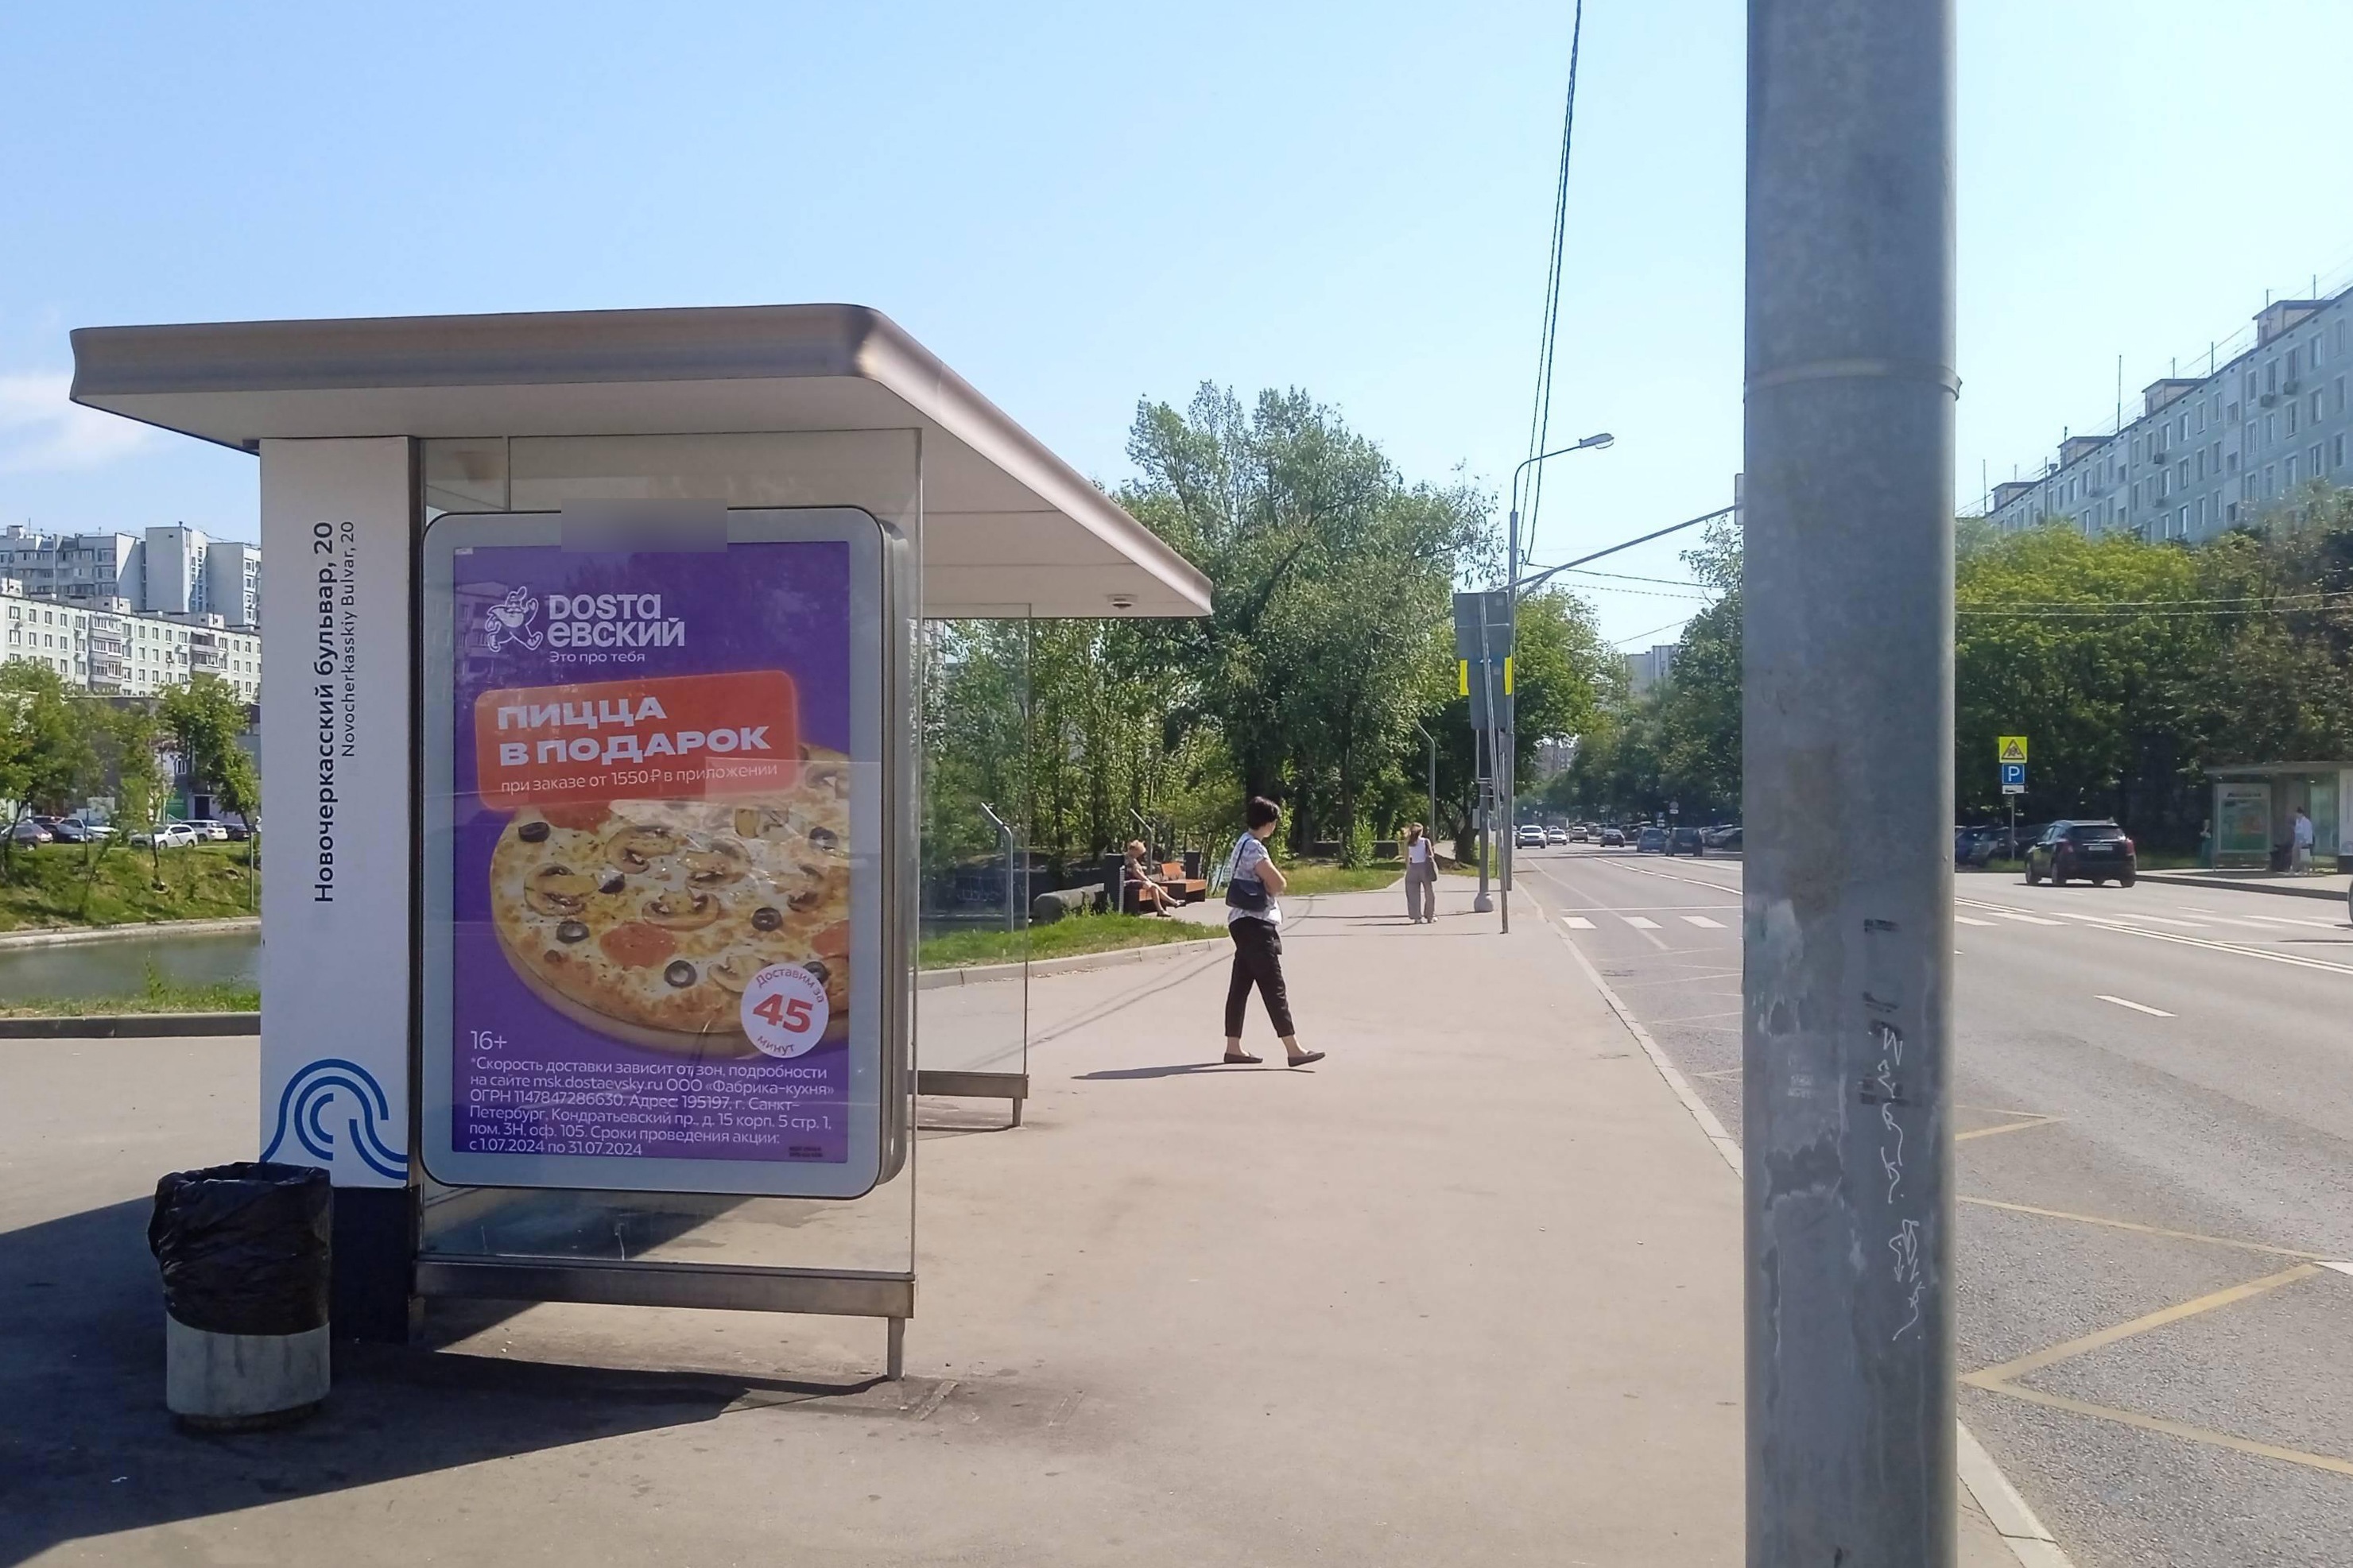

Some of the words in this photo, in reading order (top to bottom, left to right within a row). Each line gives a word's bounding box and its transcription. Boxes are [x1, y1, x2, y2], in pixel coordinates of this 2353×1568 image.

[313, 522, 333, 555] 20
[340, 521, 355, 543] 20
[340, 548, 357, 606] Bulvar,
[313, 562, 338, 676] бульвар,
[549, 651, 576, 663] Это
[580, 653, 607, 664] про
[611, 650, 645, 663] тебя
[340, 610, 358, 757] Novocherkasskiy
[498, 697, 667, 730] ПИЦЦА
[499, 742, 529, 766] В
[537, 726, 772, 765] ПОДАРОК
[314, 683, 339, 903] Новочеркасский
[501, 780, 529, 796] при
[533, 776, 586, 791] заказе
[589, 774, 607, 787] от
[664, 771, 673, 781] в
[676, 764, 777, 782] приложении
[756, 969, 815, 989] Доставим
[812, 988, 824, 1003] за
[753, 993, 813, 1033] 45
[471, 1031, 507, 1050] 16+
[758, 1036, 794, 1055] минут
[546, 1061, 612, 1074] доставки
[615, 1063, 674, 1074] зависит
[676, 1064, 692, 1074] от
[696, 1065, 726, 1077] зон,
[729, 1064, 828, 1079] подробности
[471, 1076, 486, 1086] на
[490, 1074, 531, 1087] сайте
[533, 1075, 663, 1094] msk.dostaevsky.ru
[666, 1078, 702, 1091] ООО
[705, 1080, 834, 1098] «Фабрика-кухня»
[471, 1090, 510, 1102] ОГРН
[514, 1090, 626, 1105] 1147847286630.
[630, 1094, 678, 1108] Адрес:
[681, 1095, 732, 1110] 195197,
[735, 1100, 745, 1109] г.
[748, 1097, 800, 1111] Санкт-
[470, 1105, 549, 1123] Петербург,
[552, 1108, 671, 1125] Кондратьевский
[702, 1115, 715, 1128] д.
[718, 1113, 733, 1126] 15
[736, 1116, 775, 1129] корп.
[778, 1114, 787, 1128] 5
[791, 1117, 819, 1131] стр.
[823, 1116, 831, 1130] 1,
[469, 1140, 477, 1151] с
[479, 1138, 545, 1152] 1.07.2024
[548, 1142, 565, 1152] по
[568, 1140, 642, 1156] 31.07.2024
[470, 1124, 501, 1136] пом.
[529, 1124, 556, 1139] оф.
[560, 1125, 587, 1137] 105.
[591, 1125, 636, 1141] Сроки
[639, 1129, 729, 1144] проведения
[732, 1132, 780, 1146] акции:
